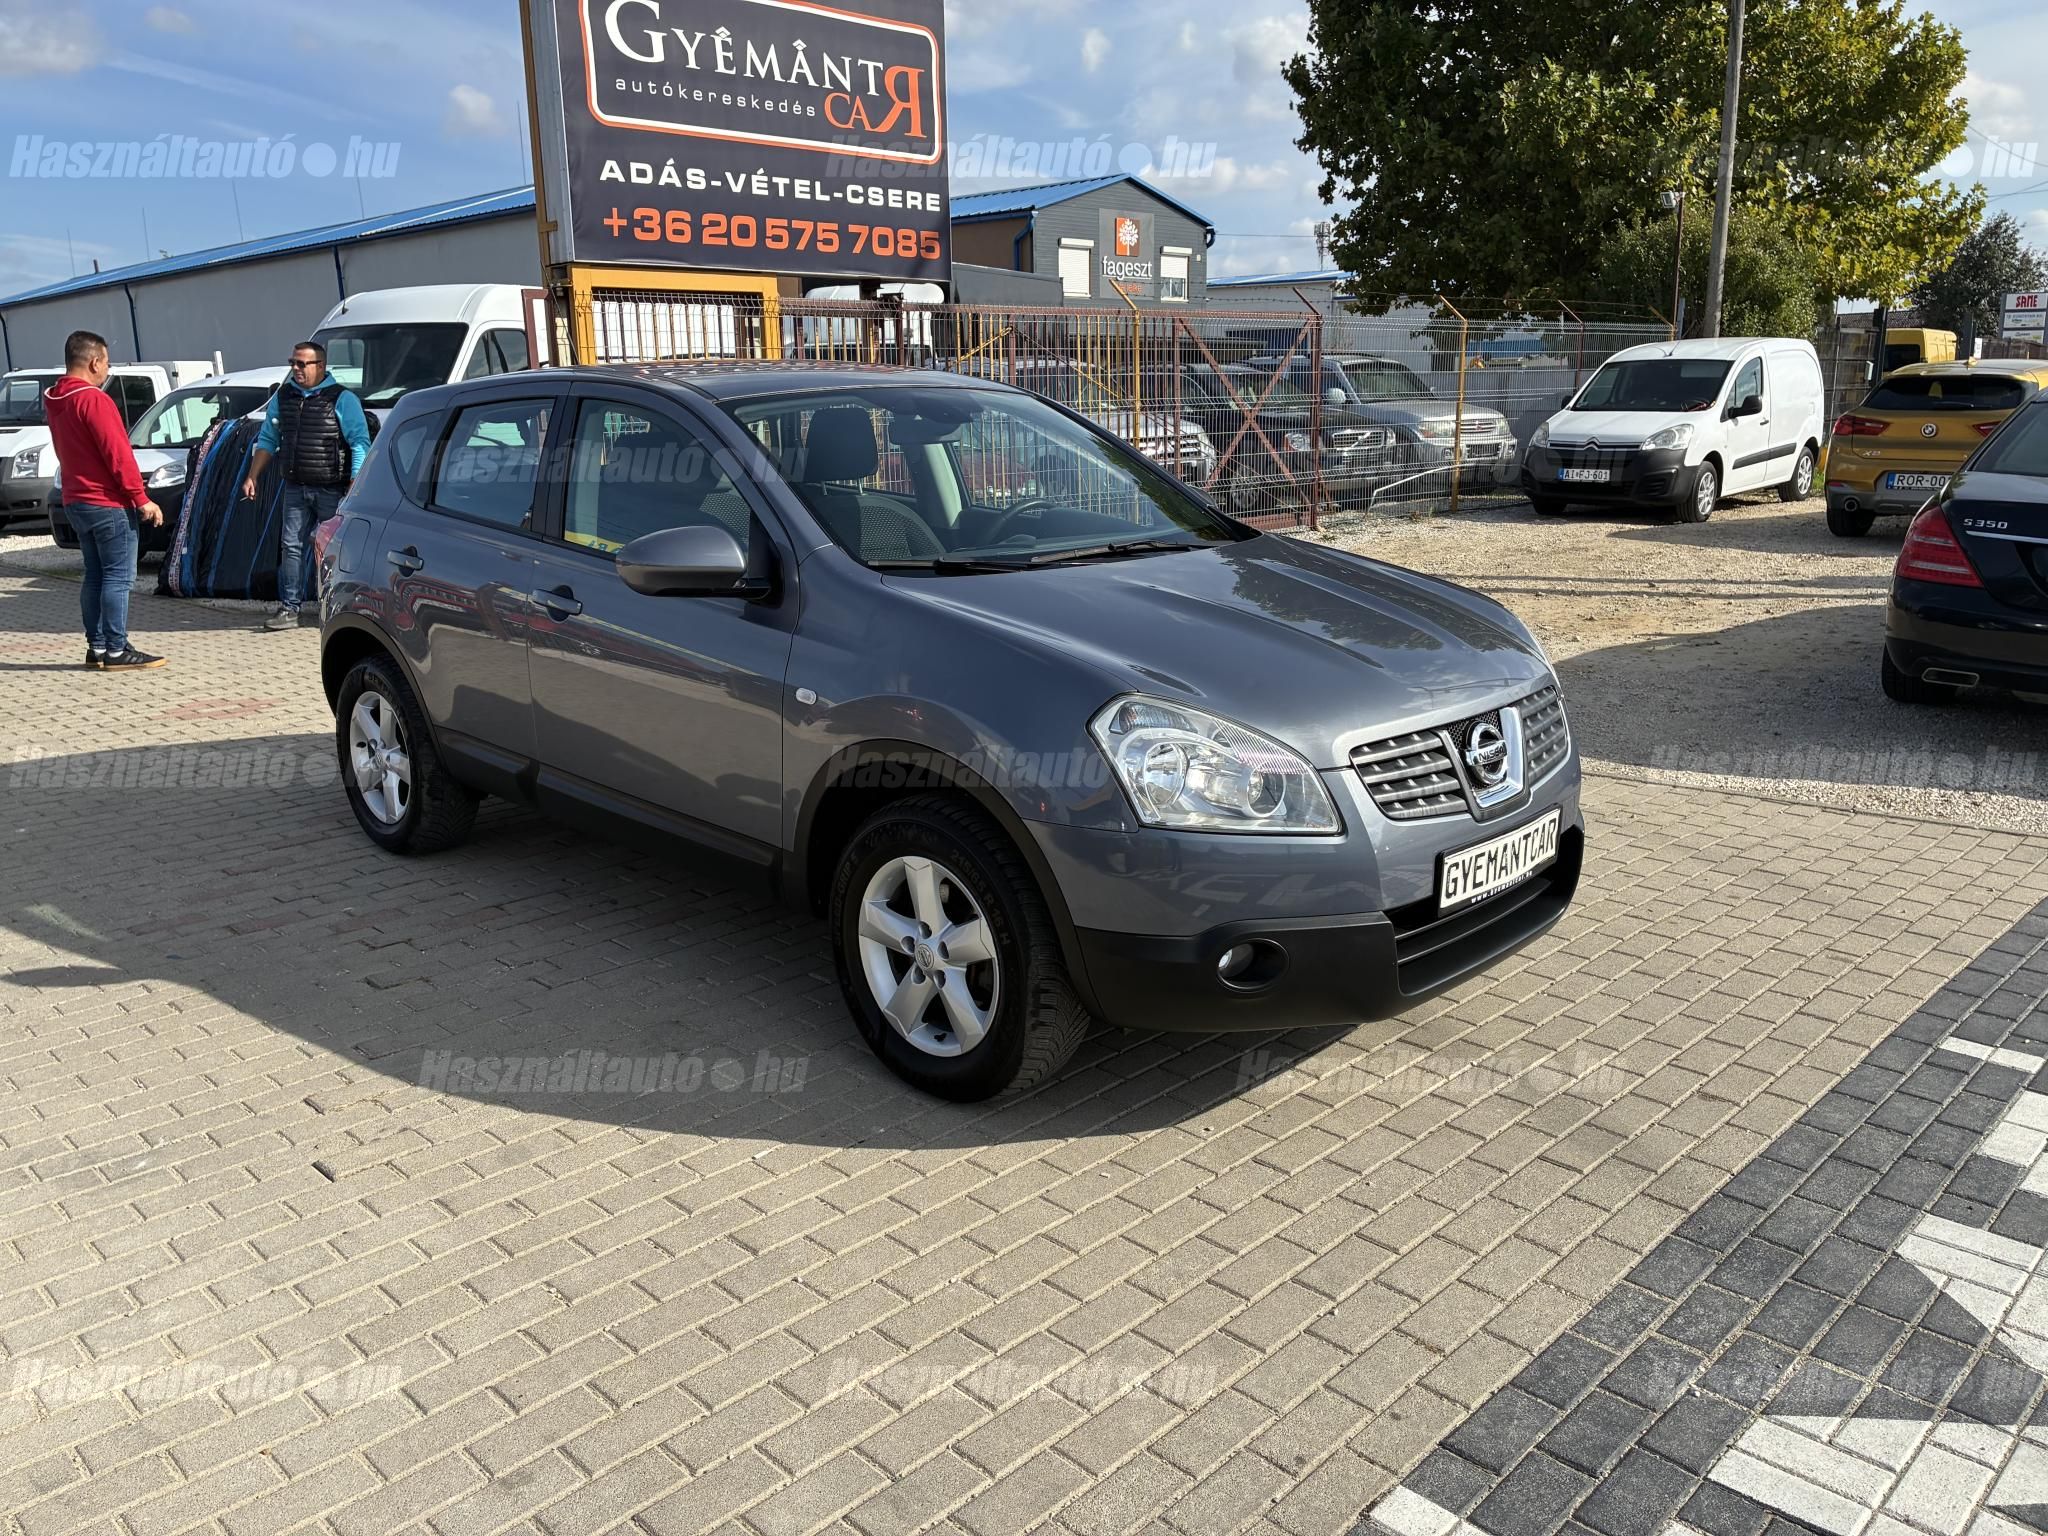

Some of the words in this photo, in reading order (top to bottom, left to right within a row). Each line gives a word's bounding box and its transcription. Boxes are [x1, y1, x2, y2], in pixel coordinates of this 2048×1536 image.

[615, 77, 817, 117] autókereskedés
[599, 157, 942, 213] ADÁS-VÉTEL-CSERE
[603, 206, 692, 245] +36
[701, 212, 757, 248] 20
[765, 217, 840, 254] 575
[847, 223, 941, 261] 7085
[1102, 255, 1153, 281] fageszt
[1897, 474, 1951, 487] ROR-00
[1444, 816, 1558, 900] GYEMANTCAR
